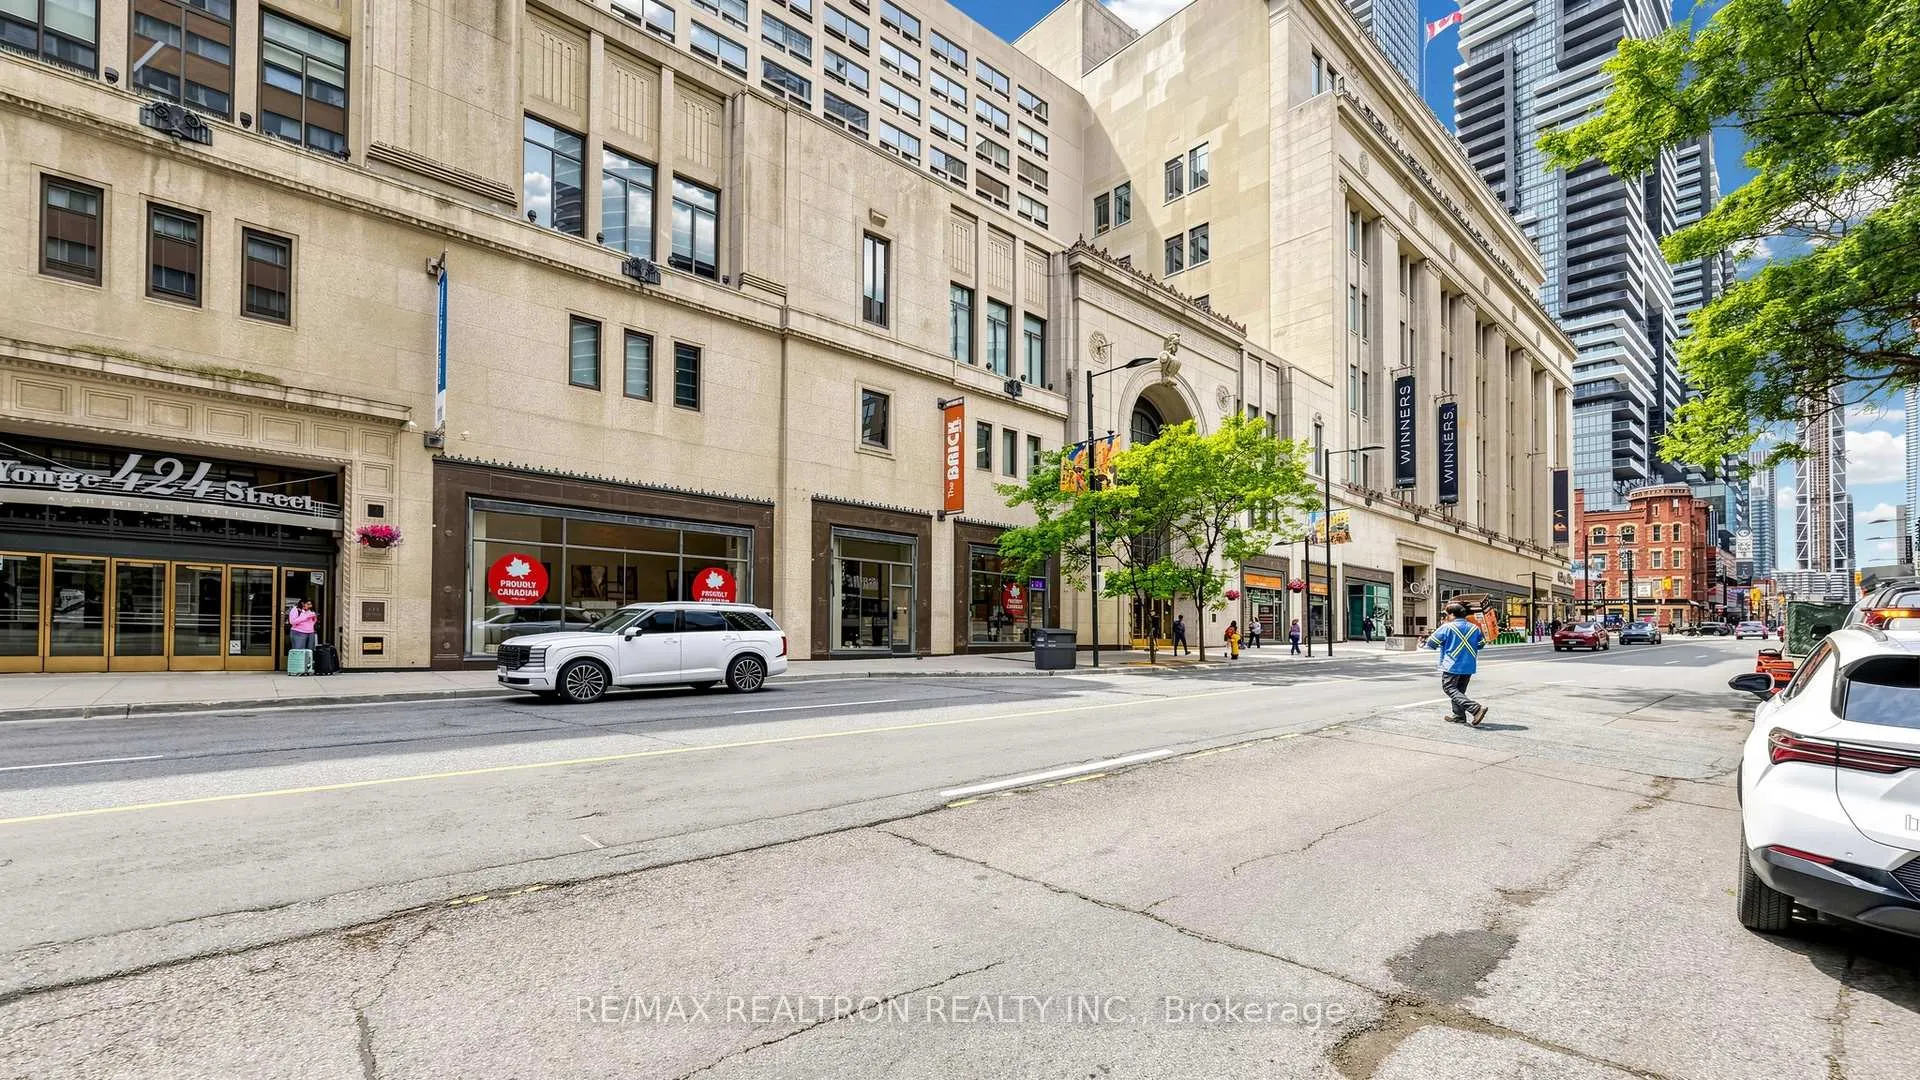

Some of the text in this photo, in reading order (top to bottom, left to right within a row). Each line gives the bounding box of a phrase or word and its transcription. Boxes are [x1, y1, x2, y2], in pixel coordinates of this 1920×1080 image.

[947, 418, 962, 480] BRICK
[1400, 385, 1411, 465] WINNERS
[1443, 411, 1454, 484] WINNERS
[110, 453, 213, 498] 424
[225, 480, 315, 511] Street
[497, 589, 539, 597] CANADIAN
[500, 580, 536, 588] PROUDLY
